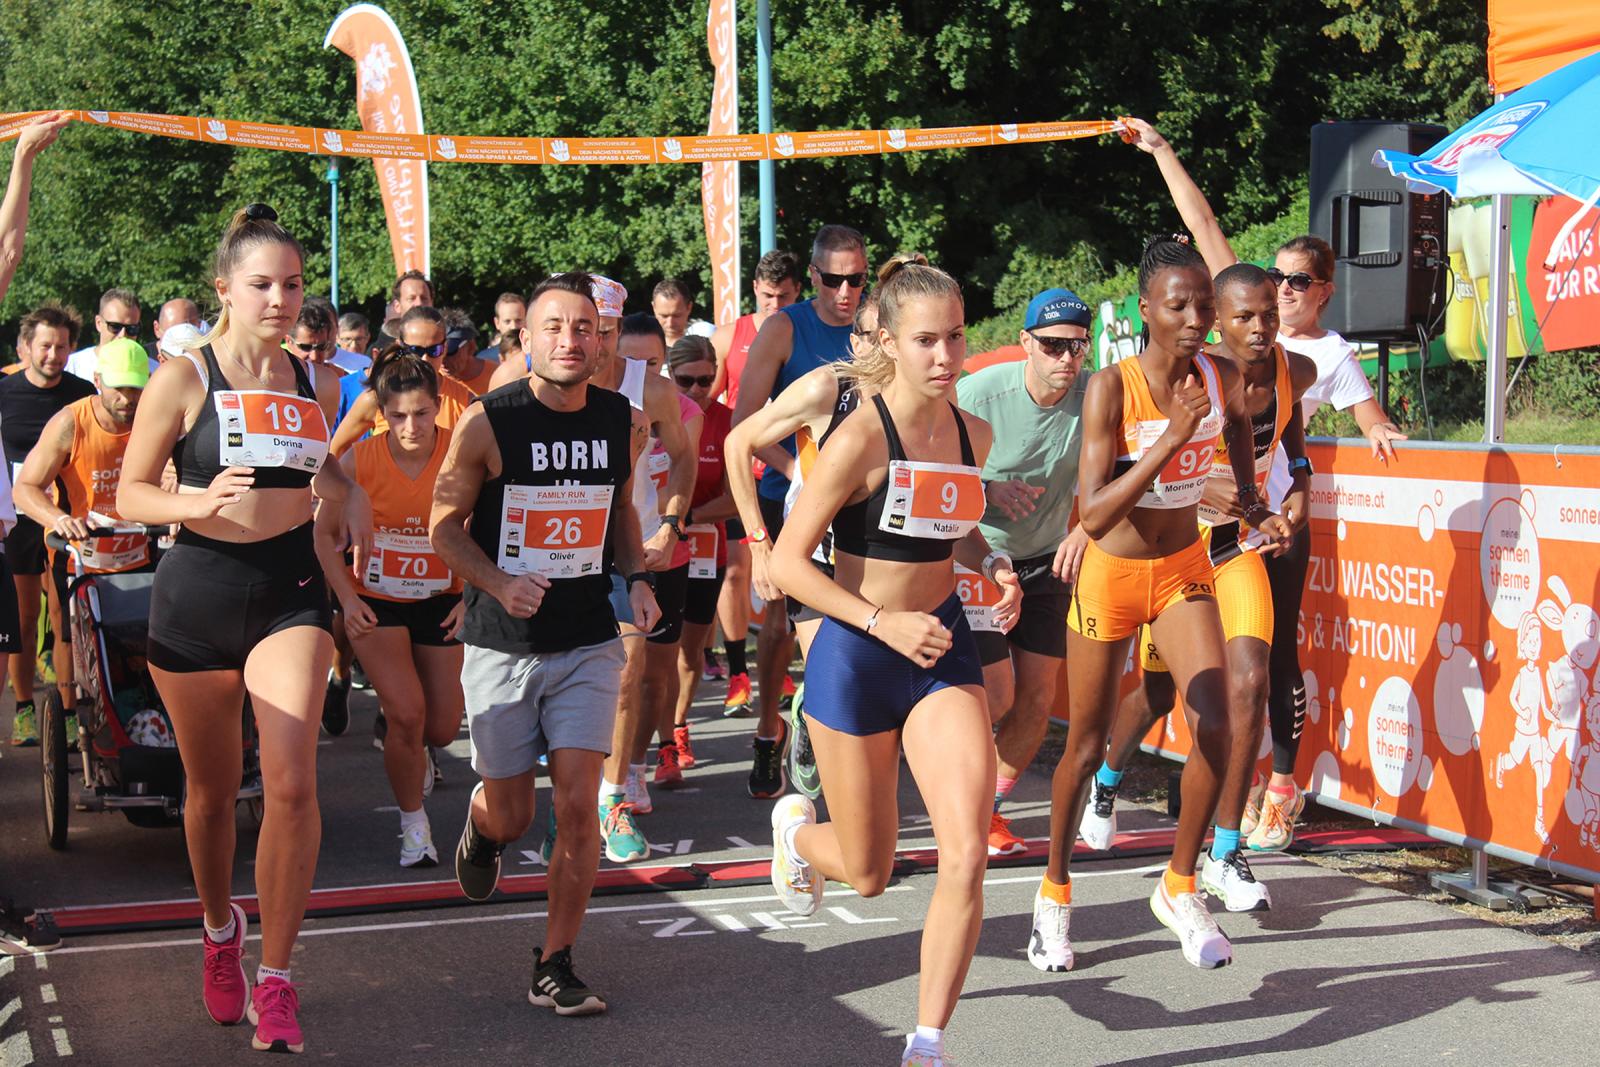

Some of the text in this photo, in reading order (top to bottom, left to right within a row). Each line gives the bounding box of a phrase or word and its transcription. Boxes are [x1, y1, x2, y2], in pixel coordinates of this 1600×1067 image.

[229, 137, 278, 147] WASSER-SPASS
[345, 147, 393, 155] WASSER-SPASS
[459, 153, 507, 161] WASSER-SPASS
[684, 151, 733, 160] WASSER-SPASS
[1545, 267, 1580, 303] ZUR
[1044, 301, 1088, 312] SALOMON
[265, 402, 302, 433] 19
[273, 438, 303, 449] Dorina
[531, 440, 608, 471] BORN
[1179, 445, 1214, 476] 92
[536, 491, 567, 499] FAMILY
[940, 481, 958, 514] 9
[1164, 483, 1195, 493] Morine
[1310, 485, 1385, 509] onnentherme.at
[406, 516, 421, 526] my
[1560, 507, 1600, 525] sonne
[543, 517, 583, 546] 26
[1500, 528, 1519, 539] meine
[112, 534, 135, 552] 71
[549, 552, 576, 561] Olivér
[1489, 545, 1531, 564] sonnen
[397, 557, 429, 577] 70
[1308, 556, 1445, 609] ZU WASSER-
[1490, 564, 1531, 590] therme
[956, 579, 984, 603] 61
[1313, 613, 1325, 649] &
[1331, 616, 1417, 666] ACTION!
[1387, 703, 1405, 714] meine
[1375, 717, 1415, 738] sonnen
[1375, 735, 1414, 762] therme
